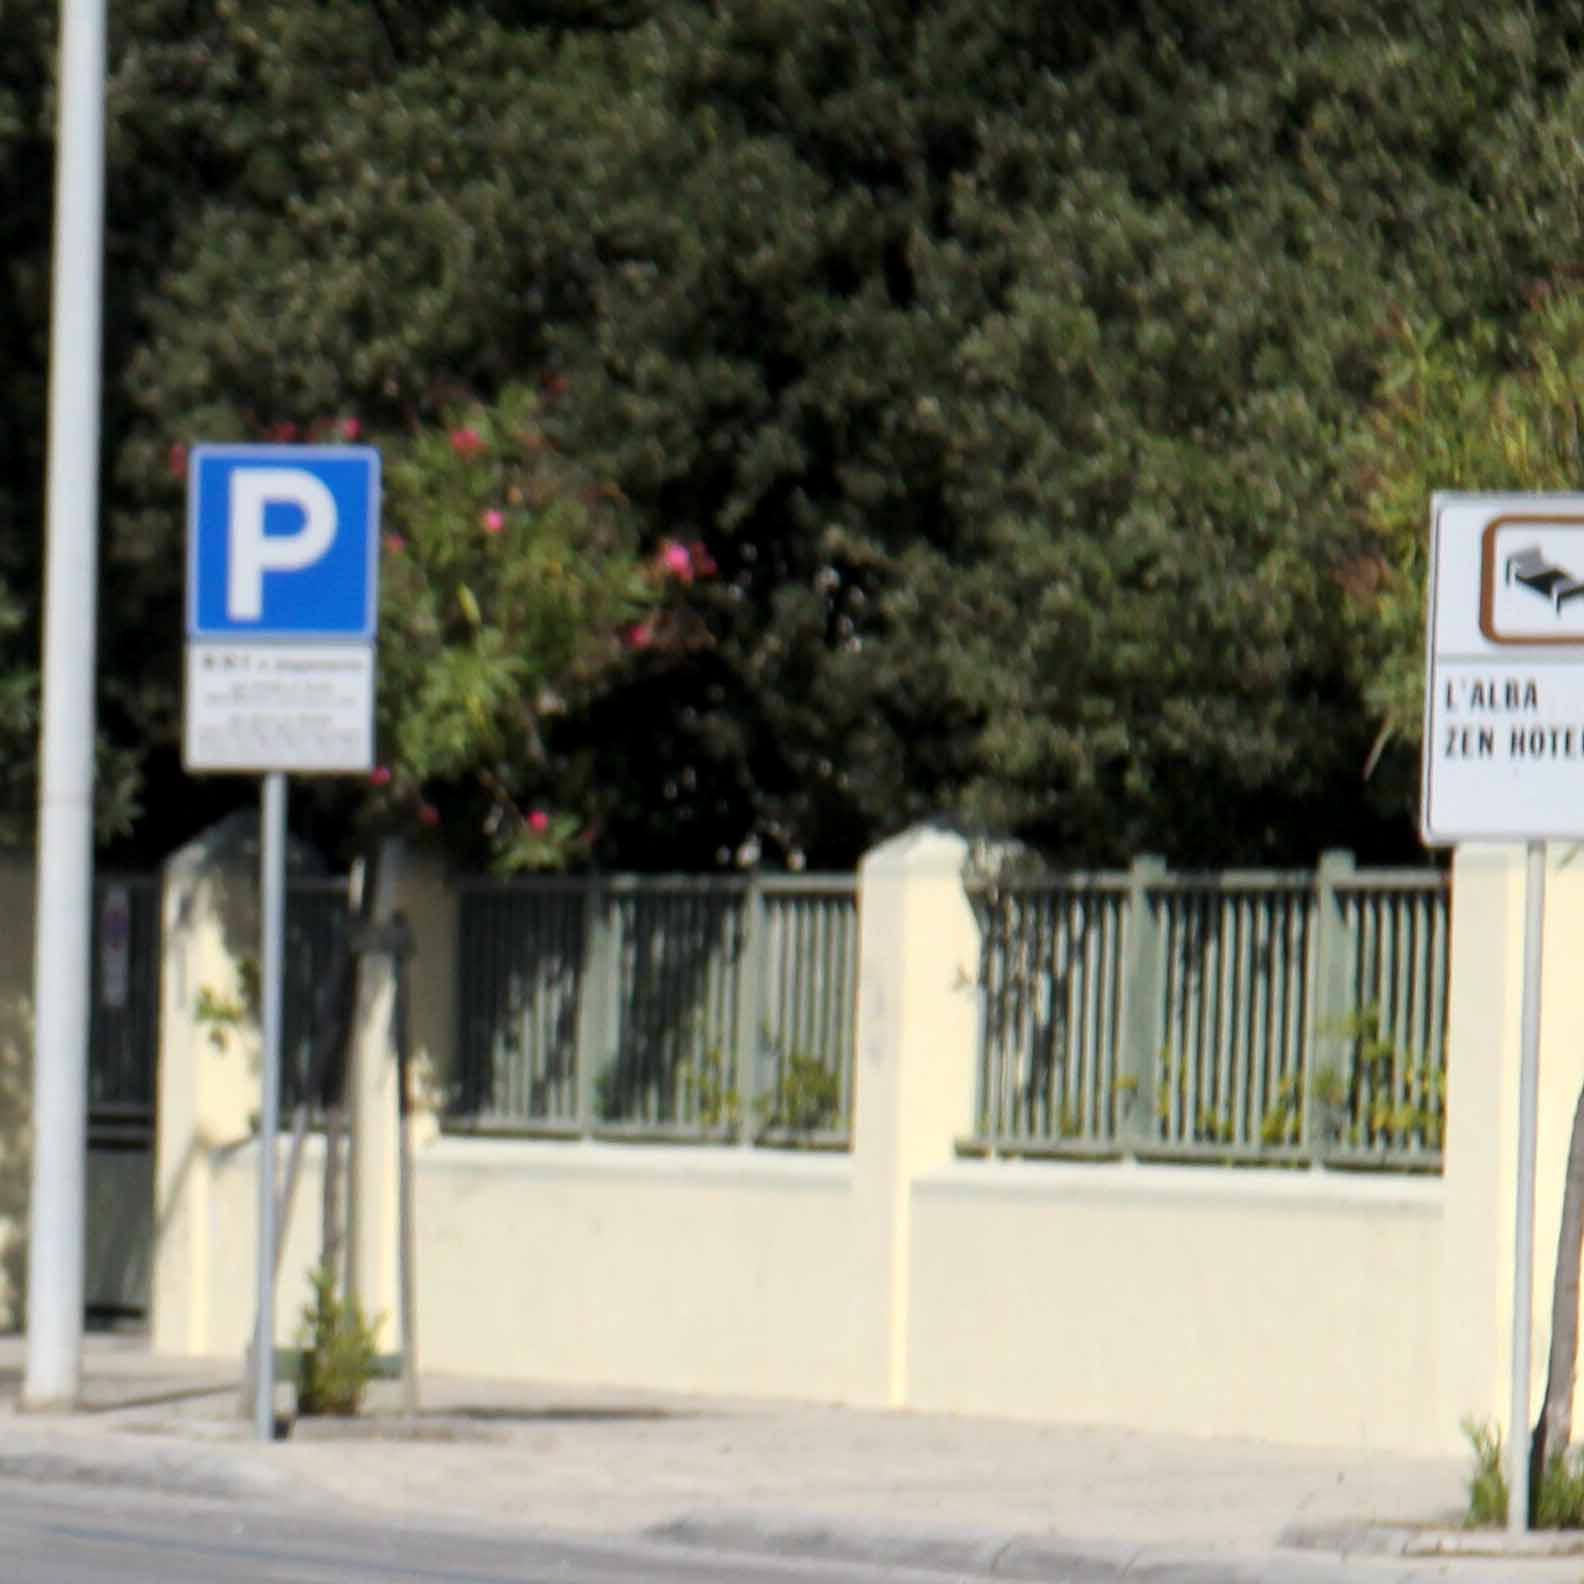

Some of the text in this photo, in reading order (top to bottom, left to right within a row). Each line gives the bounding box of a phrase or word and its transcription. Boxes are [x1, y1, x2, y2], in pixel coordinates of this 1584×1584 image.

[227, 467, 339, 622] P
[1444, 679, 1539, 711] L'ALBA
[1444, 725, 1584, 758] ZEN HOTE
